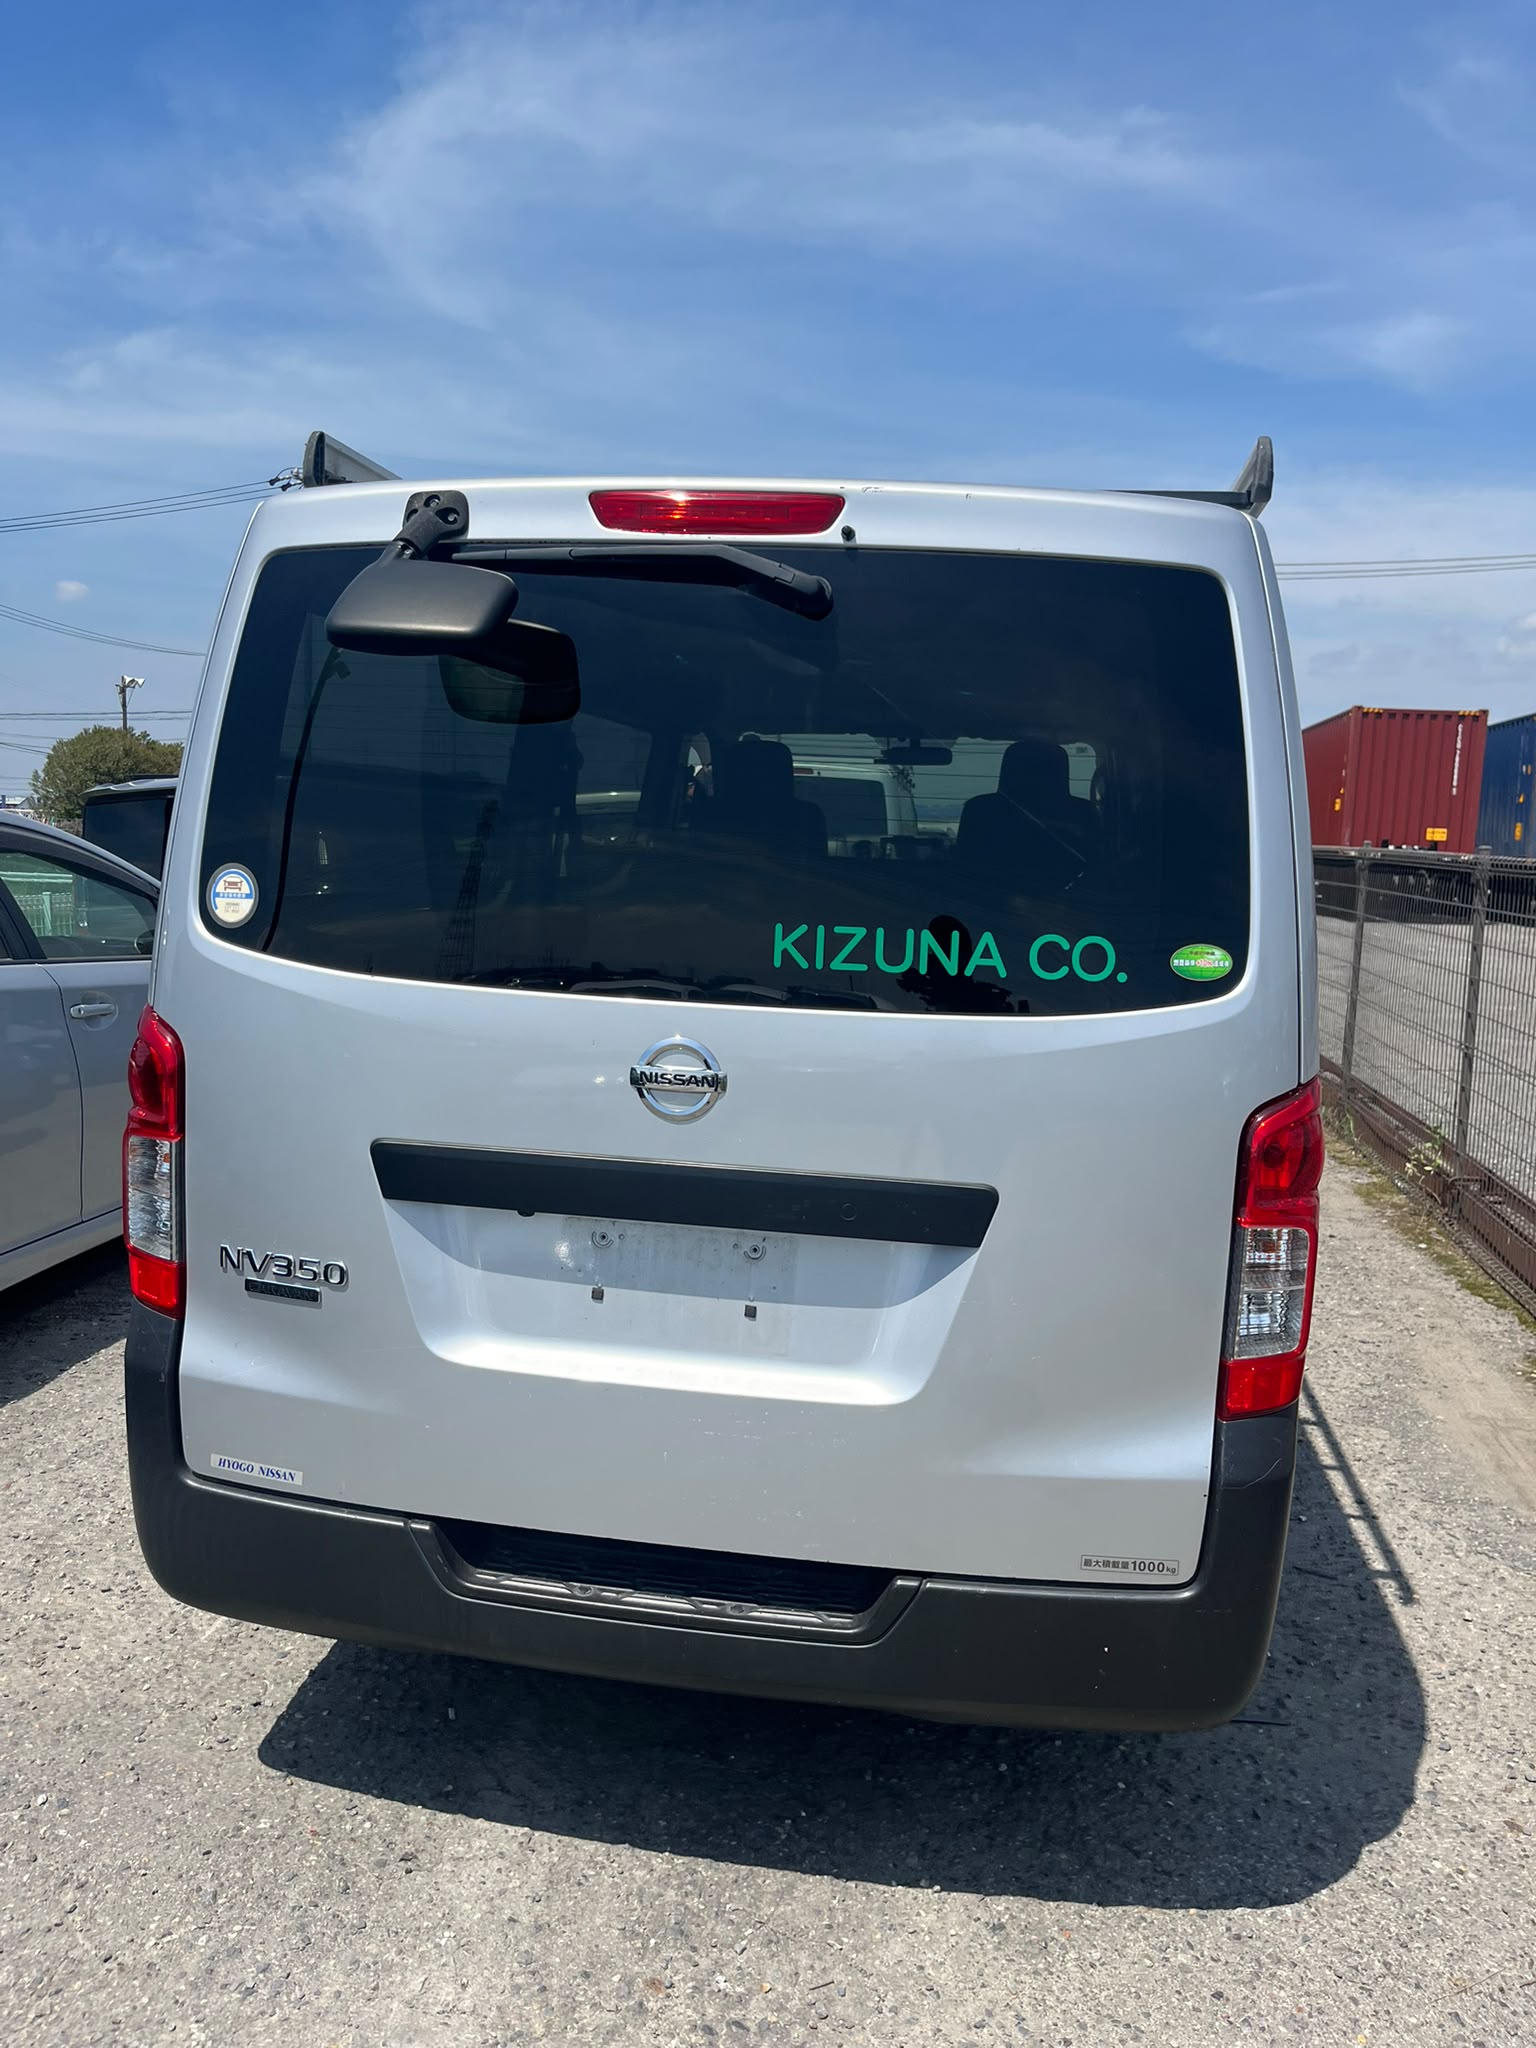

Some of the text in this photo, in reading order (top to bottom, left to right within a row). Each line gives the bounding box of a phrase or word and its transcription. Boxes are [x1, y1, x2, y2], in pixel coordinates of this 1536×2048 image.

[773, 922, 1128, 983] KIZUNA CO.
[639, 1070, 715, 1088] NISSAN
[220, 1243, 348, 1286] NV350
[218, 1457, 296, 1481] HYOGO NISSAN
